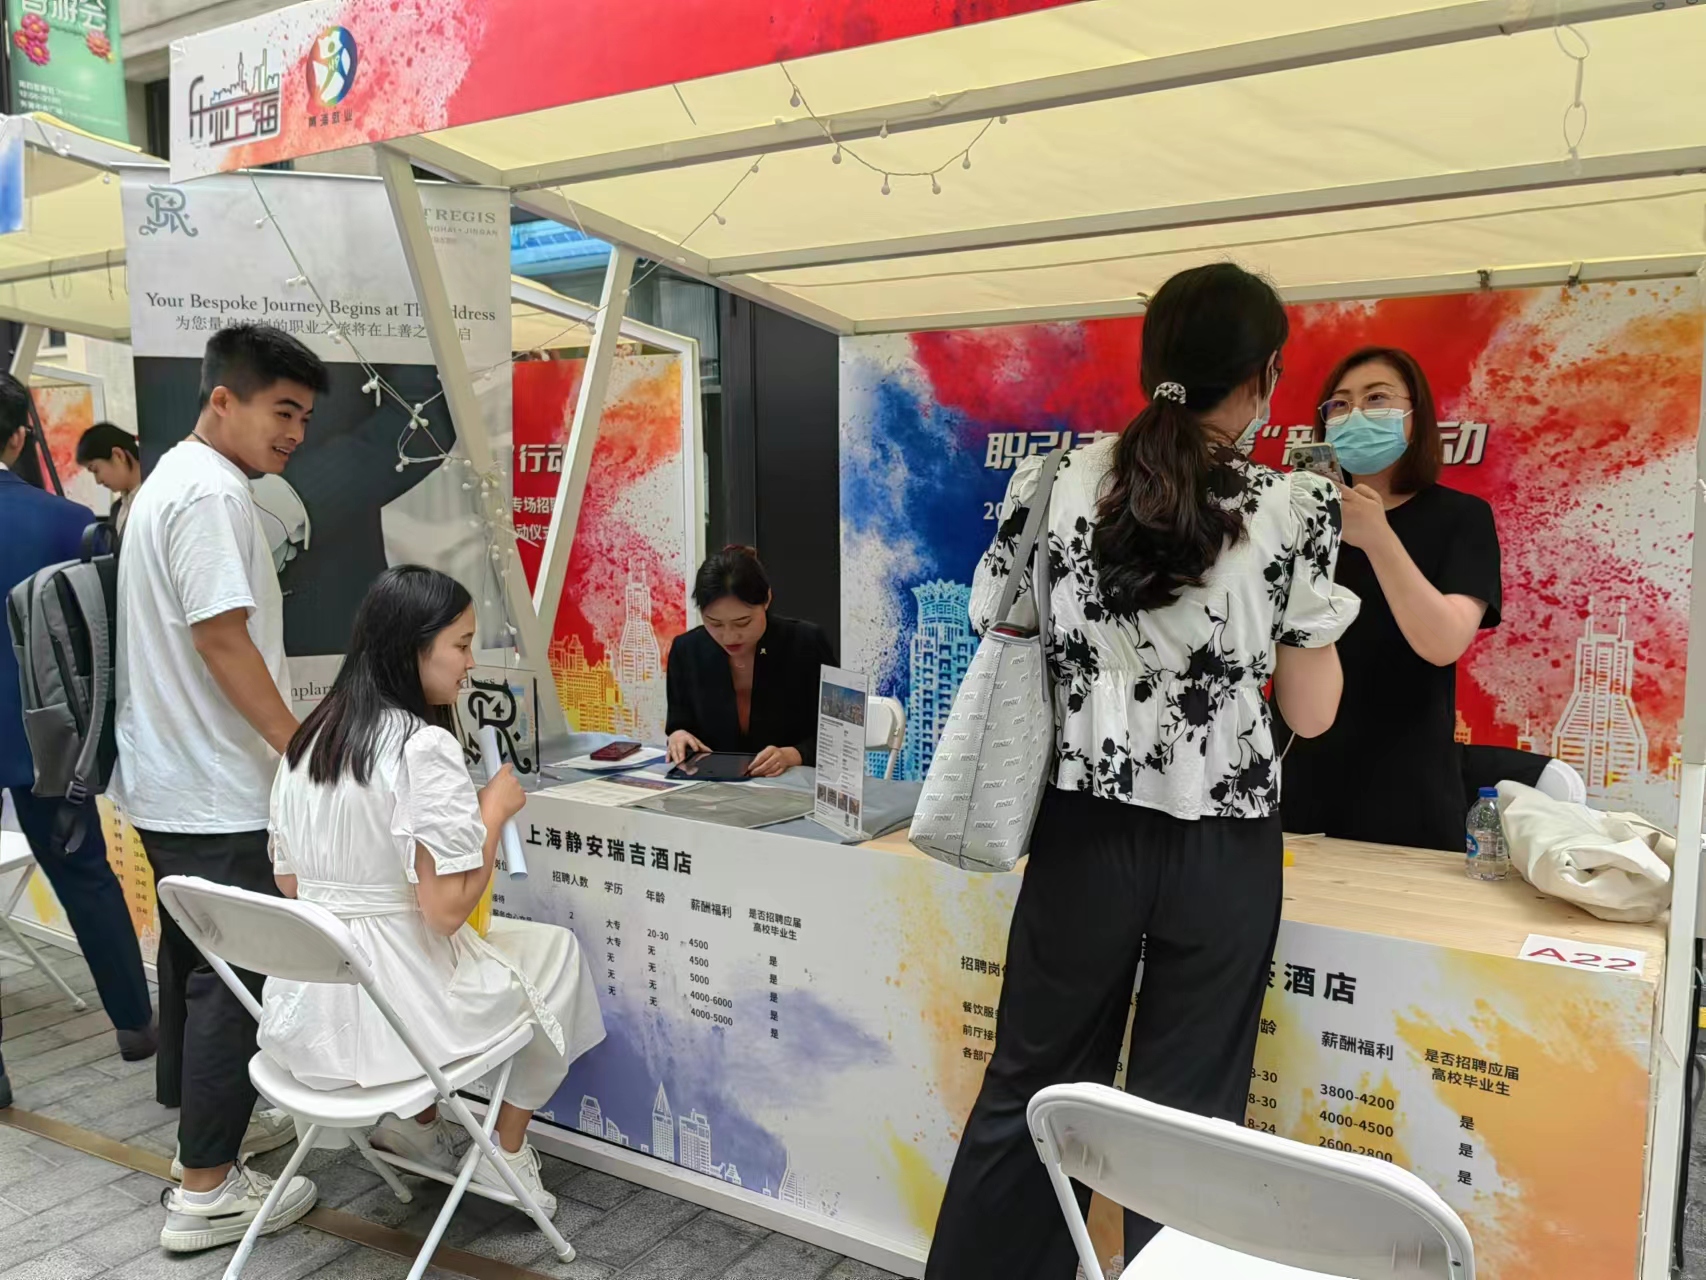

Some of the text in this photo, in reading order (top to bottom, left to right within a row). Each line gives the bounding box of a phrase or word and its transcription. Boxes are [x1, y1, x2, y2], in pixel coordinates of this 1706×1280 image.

[435, 208, 496, 224] REGIS
[146, 292, 496, 321] Your Bespoke Journey Begins at Th ddress
[526, 824, 692, 875] 上海静安瑞吉酒店
[552, 869, 589, 888] 招聘人数
[603, 881, 623, 895] 学历
[645, 889, 665, 904] 年龄
[690, 898, 732, 919] 薪酬福利
[748, 908, 802, 929] 是否招聘应届
[568, 911, 574, 920] 2
[606, 918, 621, 931] 大专
[647, 928, 669, 941] 20-30
[688, 938, 709, 950] 4500
[769, 955, 778, 967] 是
[752, 922, 798, 941] 高校毕业生
[606, 936, 621, 948] 大专
[647, 944, 656, 956] 无
[689, 955, 709, 968] 4500
[769, 973, 778, 985] 是
[606, 952, 778, 1004] 无 无 5000 是
[1526, 947, 1637, 971] A22
[607, 968, 616, 980] 无
[648, 979, 657, 990] 无
[690, 990, 733, 1009] 4000-6000
[608, 985, 616, 996] 无
[649, 995, 658, 1007] 无
[690, 1007, 733, 1026] 4000-5000
[1258, 1017, 1277, 1036] 龄
[1321, 1030, 1394, 1061] 薪酬福利
[1424, 1048, 1520, 1081] 是否招聘应届
[962, 1023, 1473, 1158] 前厅接 8-30 4000-4500 是
[1431, 1067, 1511, 1097] 高校毕业生
[1320, 1083, 1395, 1111] 3800-4200
[1459, 1114, 1475, 1131] 是
[1247, 1118, 1277, 1135] 8-24
[1318, 1136, 1393, 1163] 2600-2800
[1457, 1170, 1473, 1186] 是
